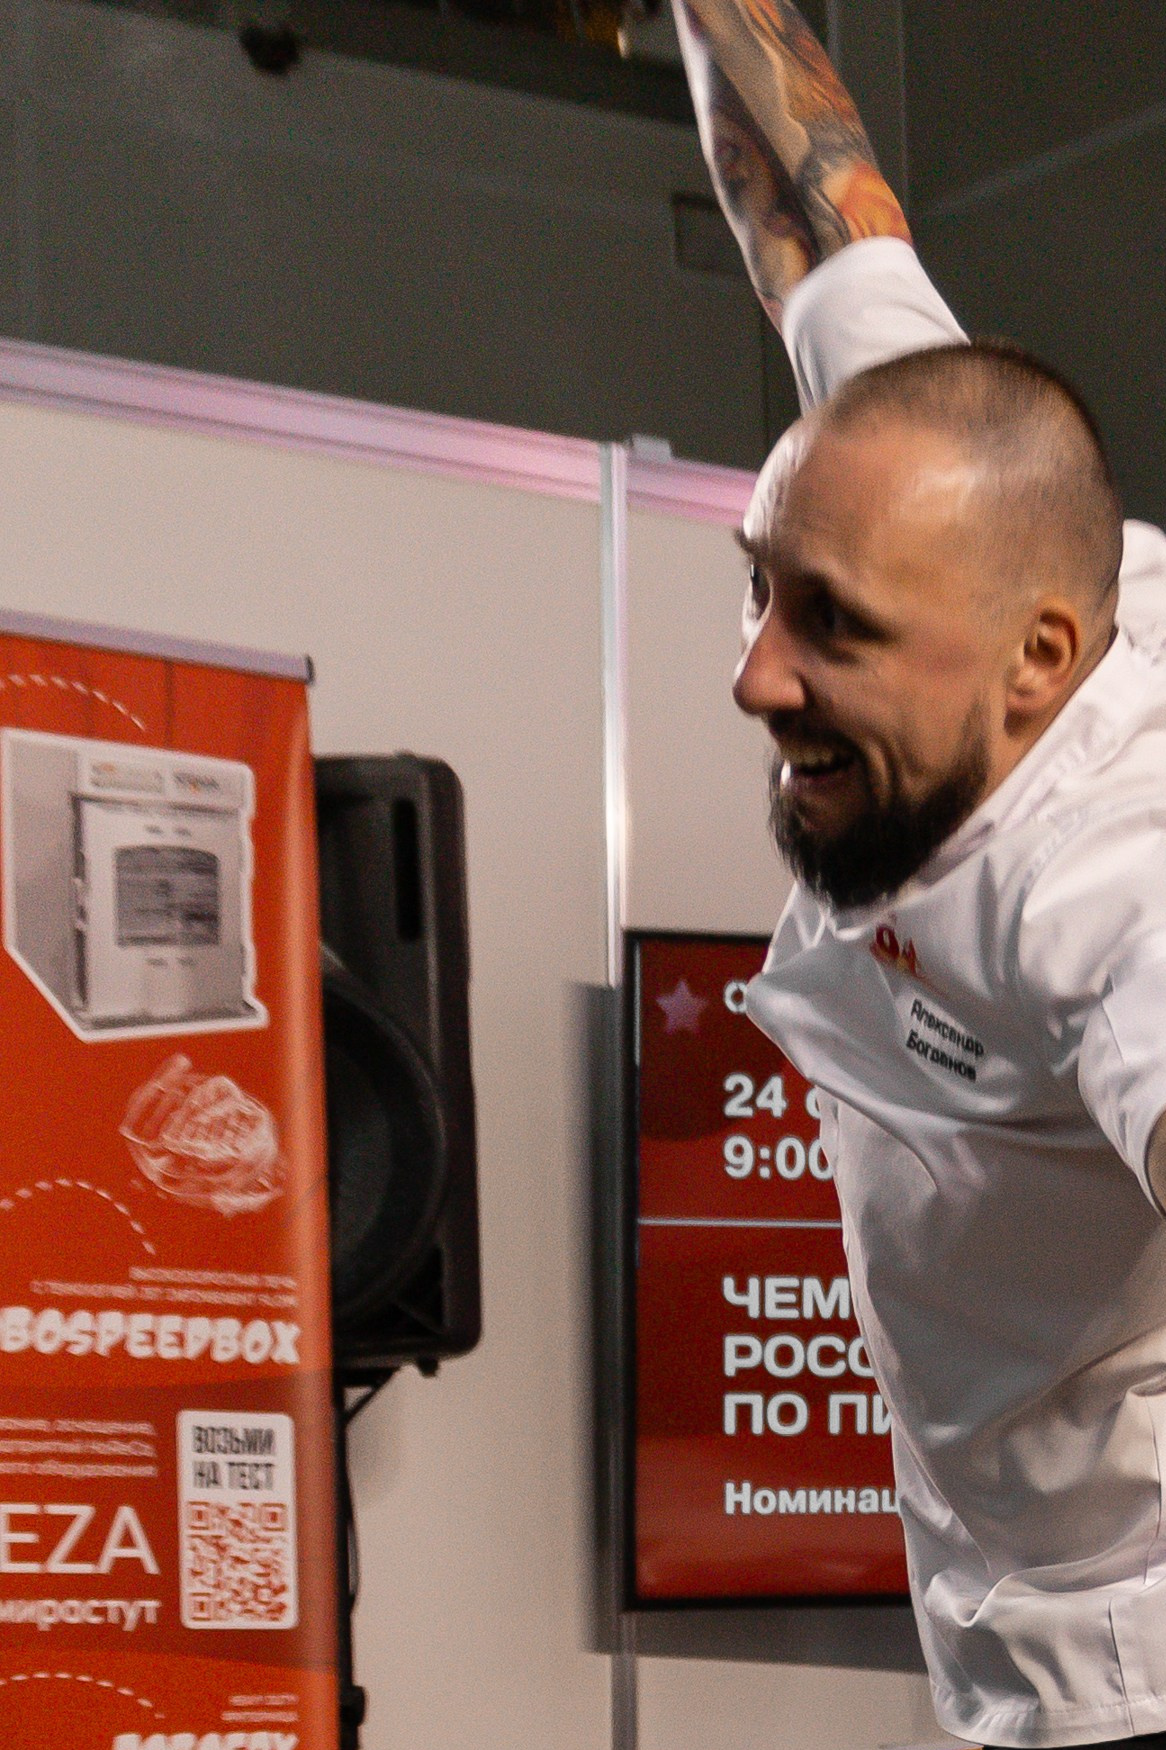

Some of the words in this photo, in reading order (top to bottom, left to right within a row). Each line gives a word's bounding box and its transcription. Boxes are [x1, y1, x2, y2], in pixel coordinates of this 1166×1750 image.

[724, 1074, 788, 1118] 24
[723, 1276, 851, 1320] ЧЕМ
[723, 1393, 808, 1436] ПО
[0, 1503, 161, 1575] EZA
